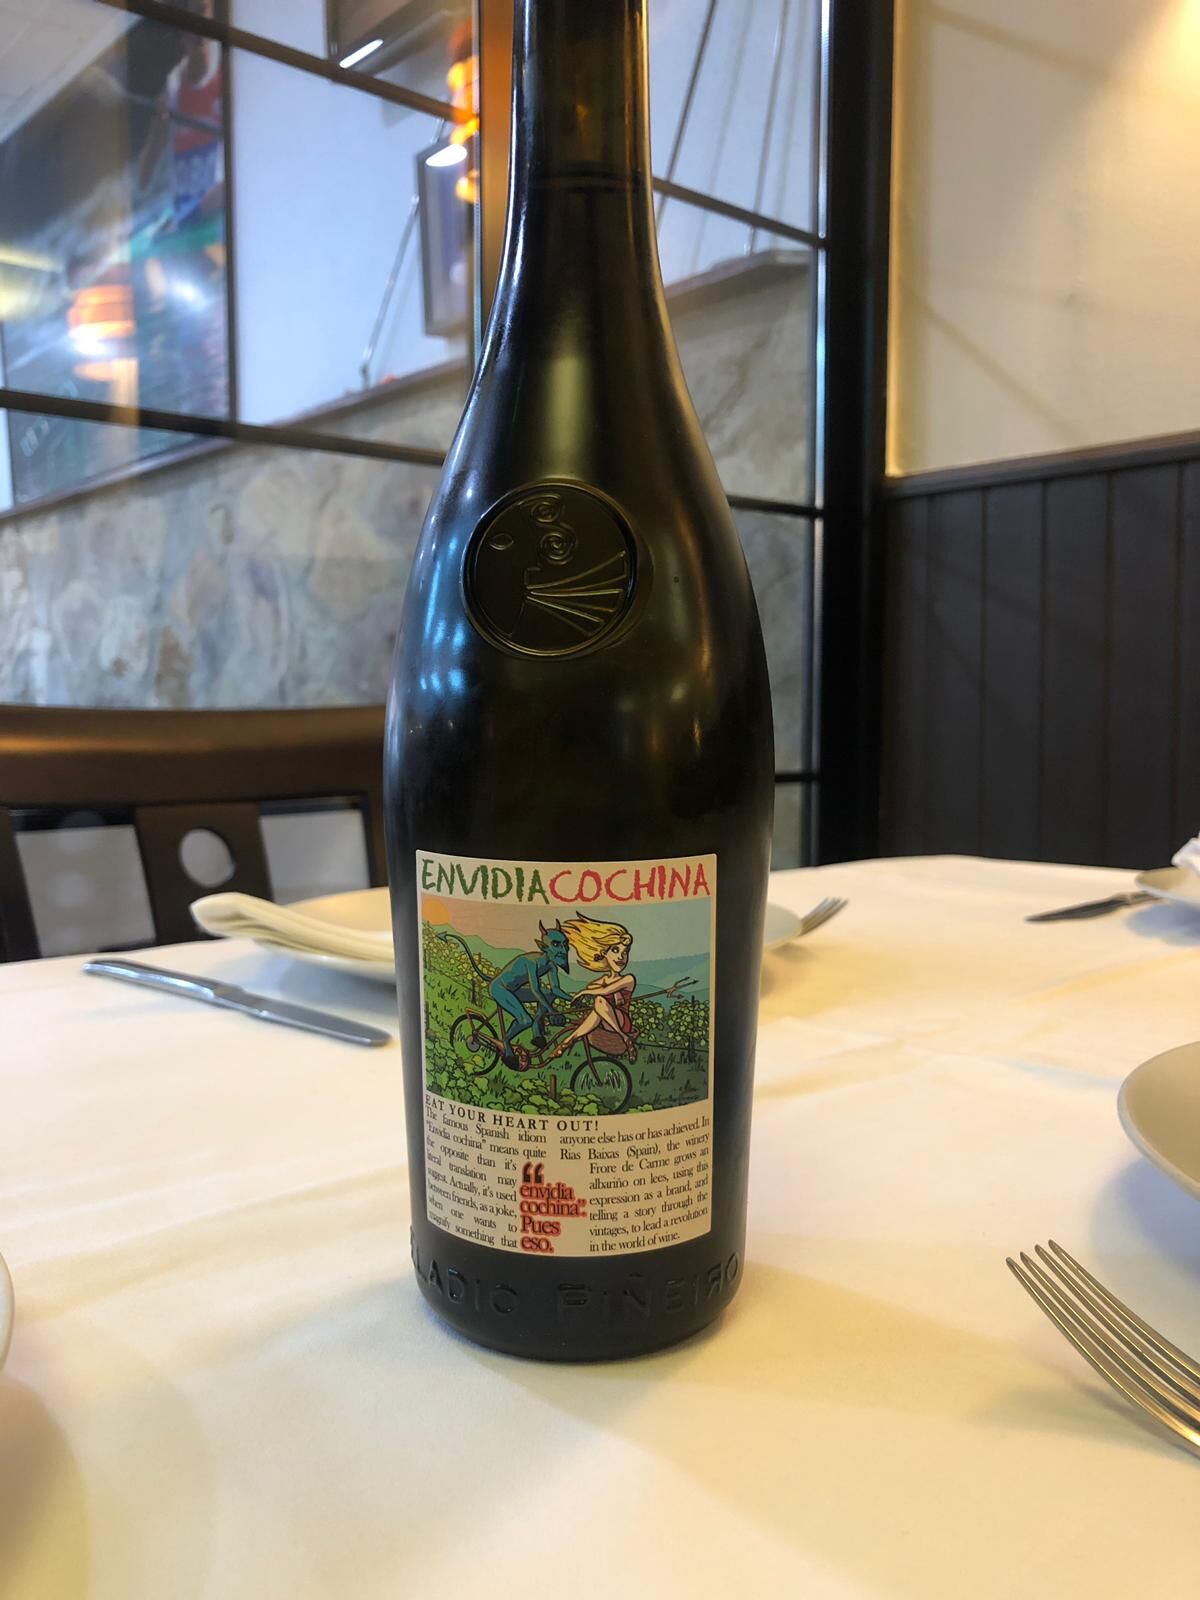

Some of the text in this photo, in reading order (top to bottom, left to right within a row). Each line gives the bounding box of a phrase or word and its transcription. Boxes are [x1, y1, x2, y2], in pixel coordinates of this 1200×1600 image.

[425, 1094, 598, 1131] EAT YOUR HEART OUT!
[442, 1113, 468, 1131] famous
[476, 1123, 509, 1139] Spanish
[518, 1130, 546, 1143] idiom
[560, 1134, 596, 1146] anyone
[598, 1132, 616, 1143] else
[618, 1131, 634, 1142] has
[635, 1132, 646, 1140] or
[648, 1128, 662, 1139] has
[440, 1144, 469, 1161] opposite
[477, 1154, 496, 1167] than
[490, 1144, 519, 1155] means
[522, 1146, 546, 1159] quite
[588, 1148, 620, 1160] Baixas
[626, 1143, 660, 1159] (Spain),
[666, 1140, 680, 1152] the
[686, 1133, 709, 1146] winery
[590, 1162, 616, 1174] Frore
[622, 1160, 634, 1172] de
[674, 1150, 696, 1164] grows
[633, 1178, 646, 1186] on
[673, 1166, 694, 1180] using
[696, 1160, 708, 1172] this
[448, 1162, 486, 1181] translation
[497, 1176, 517, 1188] may
[496, 1191, 516, 1202] used
[520, 1182, 575, 1200] envidia
[589, 1192, 640, 1207] expression
[644, 1192, 654, 1200] as
[657, 1190, 662, 1198] a
[695, 1174, 708, 1188] and
[480, 1203, 488, 1212] as
[494, 1203, 518, 1218] joke,
[590, 1192, 708, 1222] telling a story through the
[450, 1208, 464, 1220] one
[474, 1216, 496, 1229] wants
[508, 1224, 518, 1232] to
[520, 1215, 561, 1236] Pues
[590, 1225, 629, 1237] vintages,
[632, 1224, 640, 1233] to
[643, 1217, 661, 1232] lead
[670, 1207, 708, 1226] revolution
[456, 1225, 494, 1246] something
[501, 1236, 518, 1248] that
[521, 1236, 554, 1254] eso.
[590, 1231, 680, 1252] in the world of wine.
